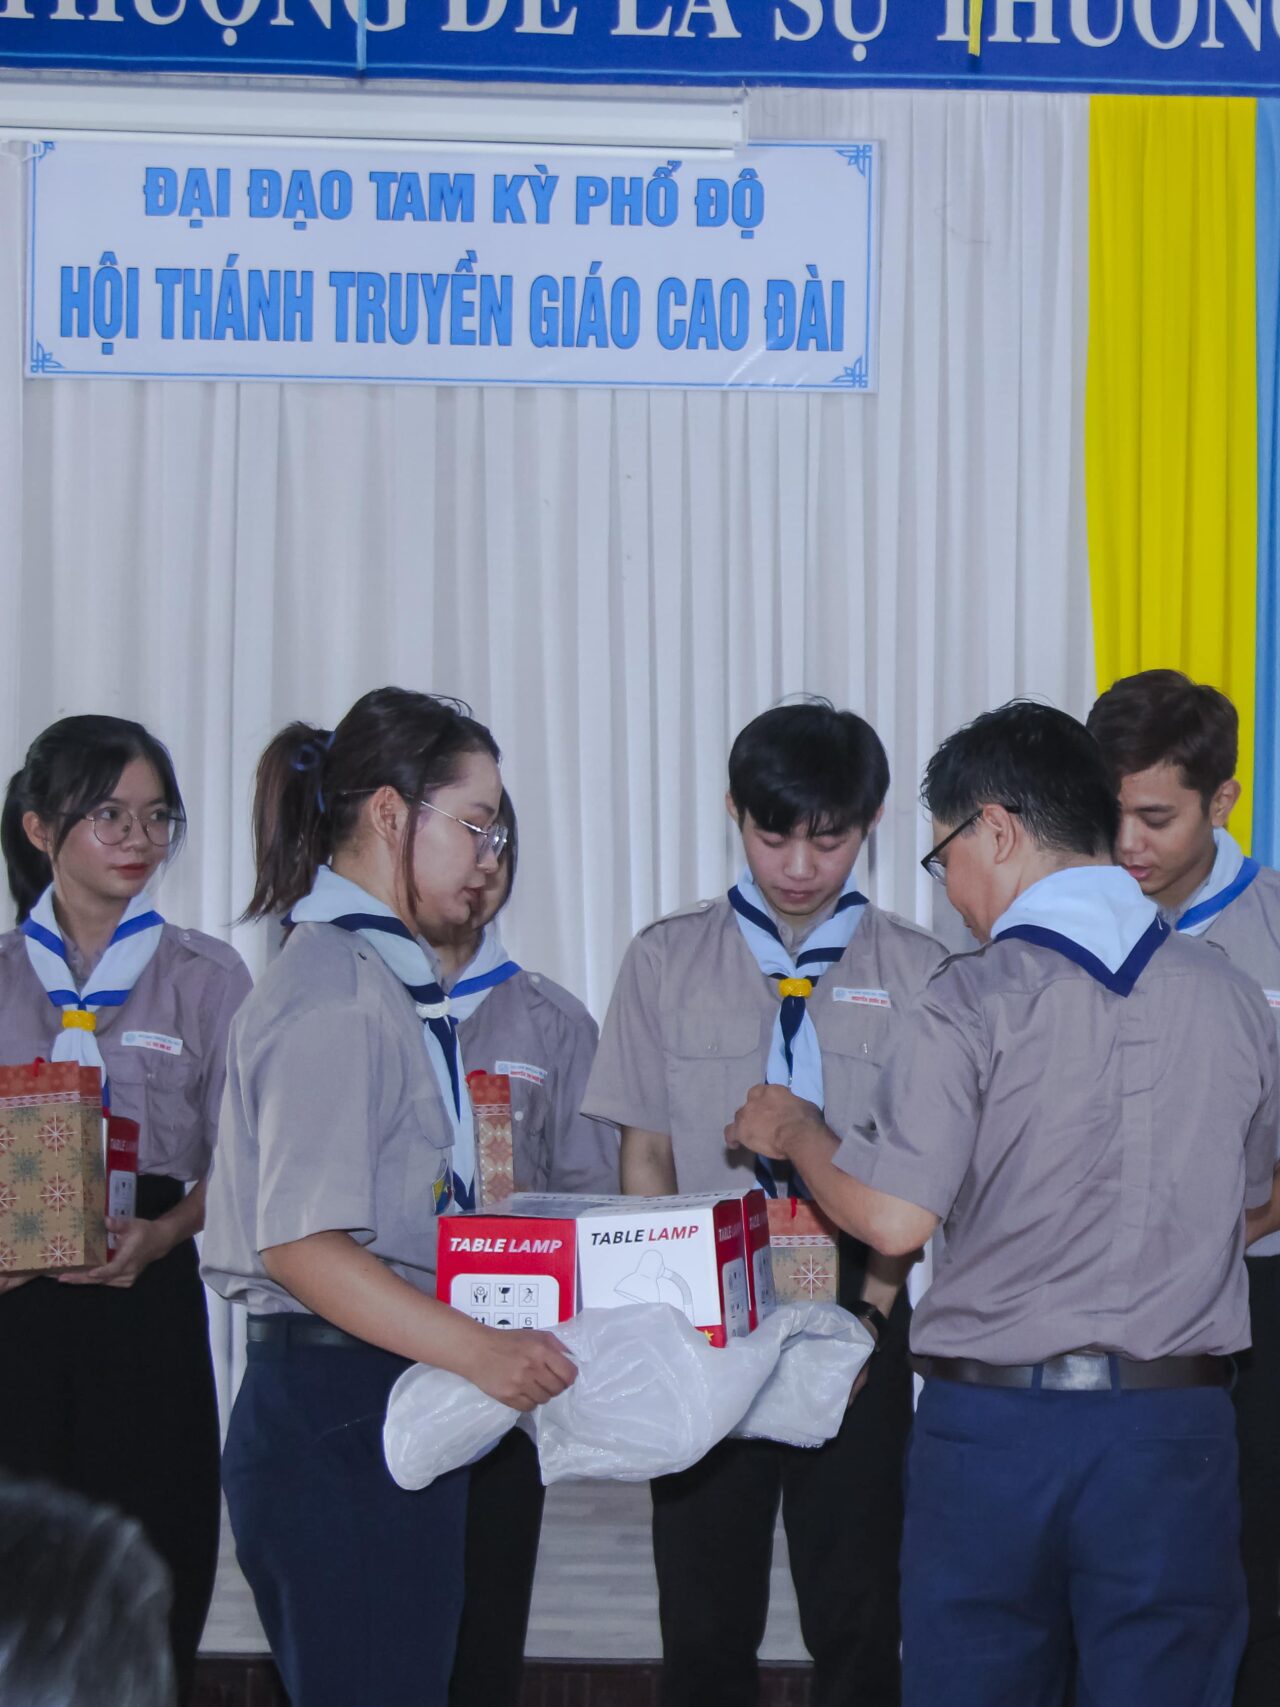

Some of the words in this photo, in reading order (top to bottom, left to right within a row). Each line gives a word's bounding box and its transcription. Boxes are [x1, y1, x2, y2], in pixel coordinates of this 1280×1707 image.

[143, 167, 231, 228] ĐẠI
[247, 169, 352, 230] ĐẠO
[369, 171, 475, 222] TAM
[493, 164, 559, 224] KỲ
[575, 160, 682, 227] PHỔ
[694, 168, 765, 239] ĐỘ
[60, 251, 139, 355] HỘI
[155, 253, 313, 342] THÁNH
[329, 250, 513, 346] TRUYỀN
[529, 261, 640, 349] GIÁO
[657, 277, 749, 351] CAO
[764, 264, 845, 352] ĐÀI
[450, 1237, 507, 1253] TABLE
[508, 1239, 563, 1254] LAMP
[591, 1229, 645, 1246] TABLE
[648, 1225, 699, 1242] LAMP
